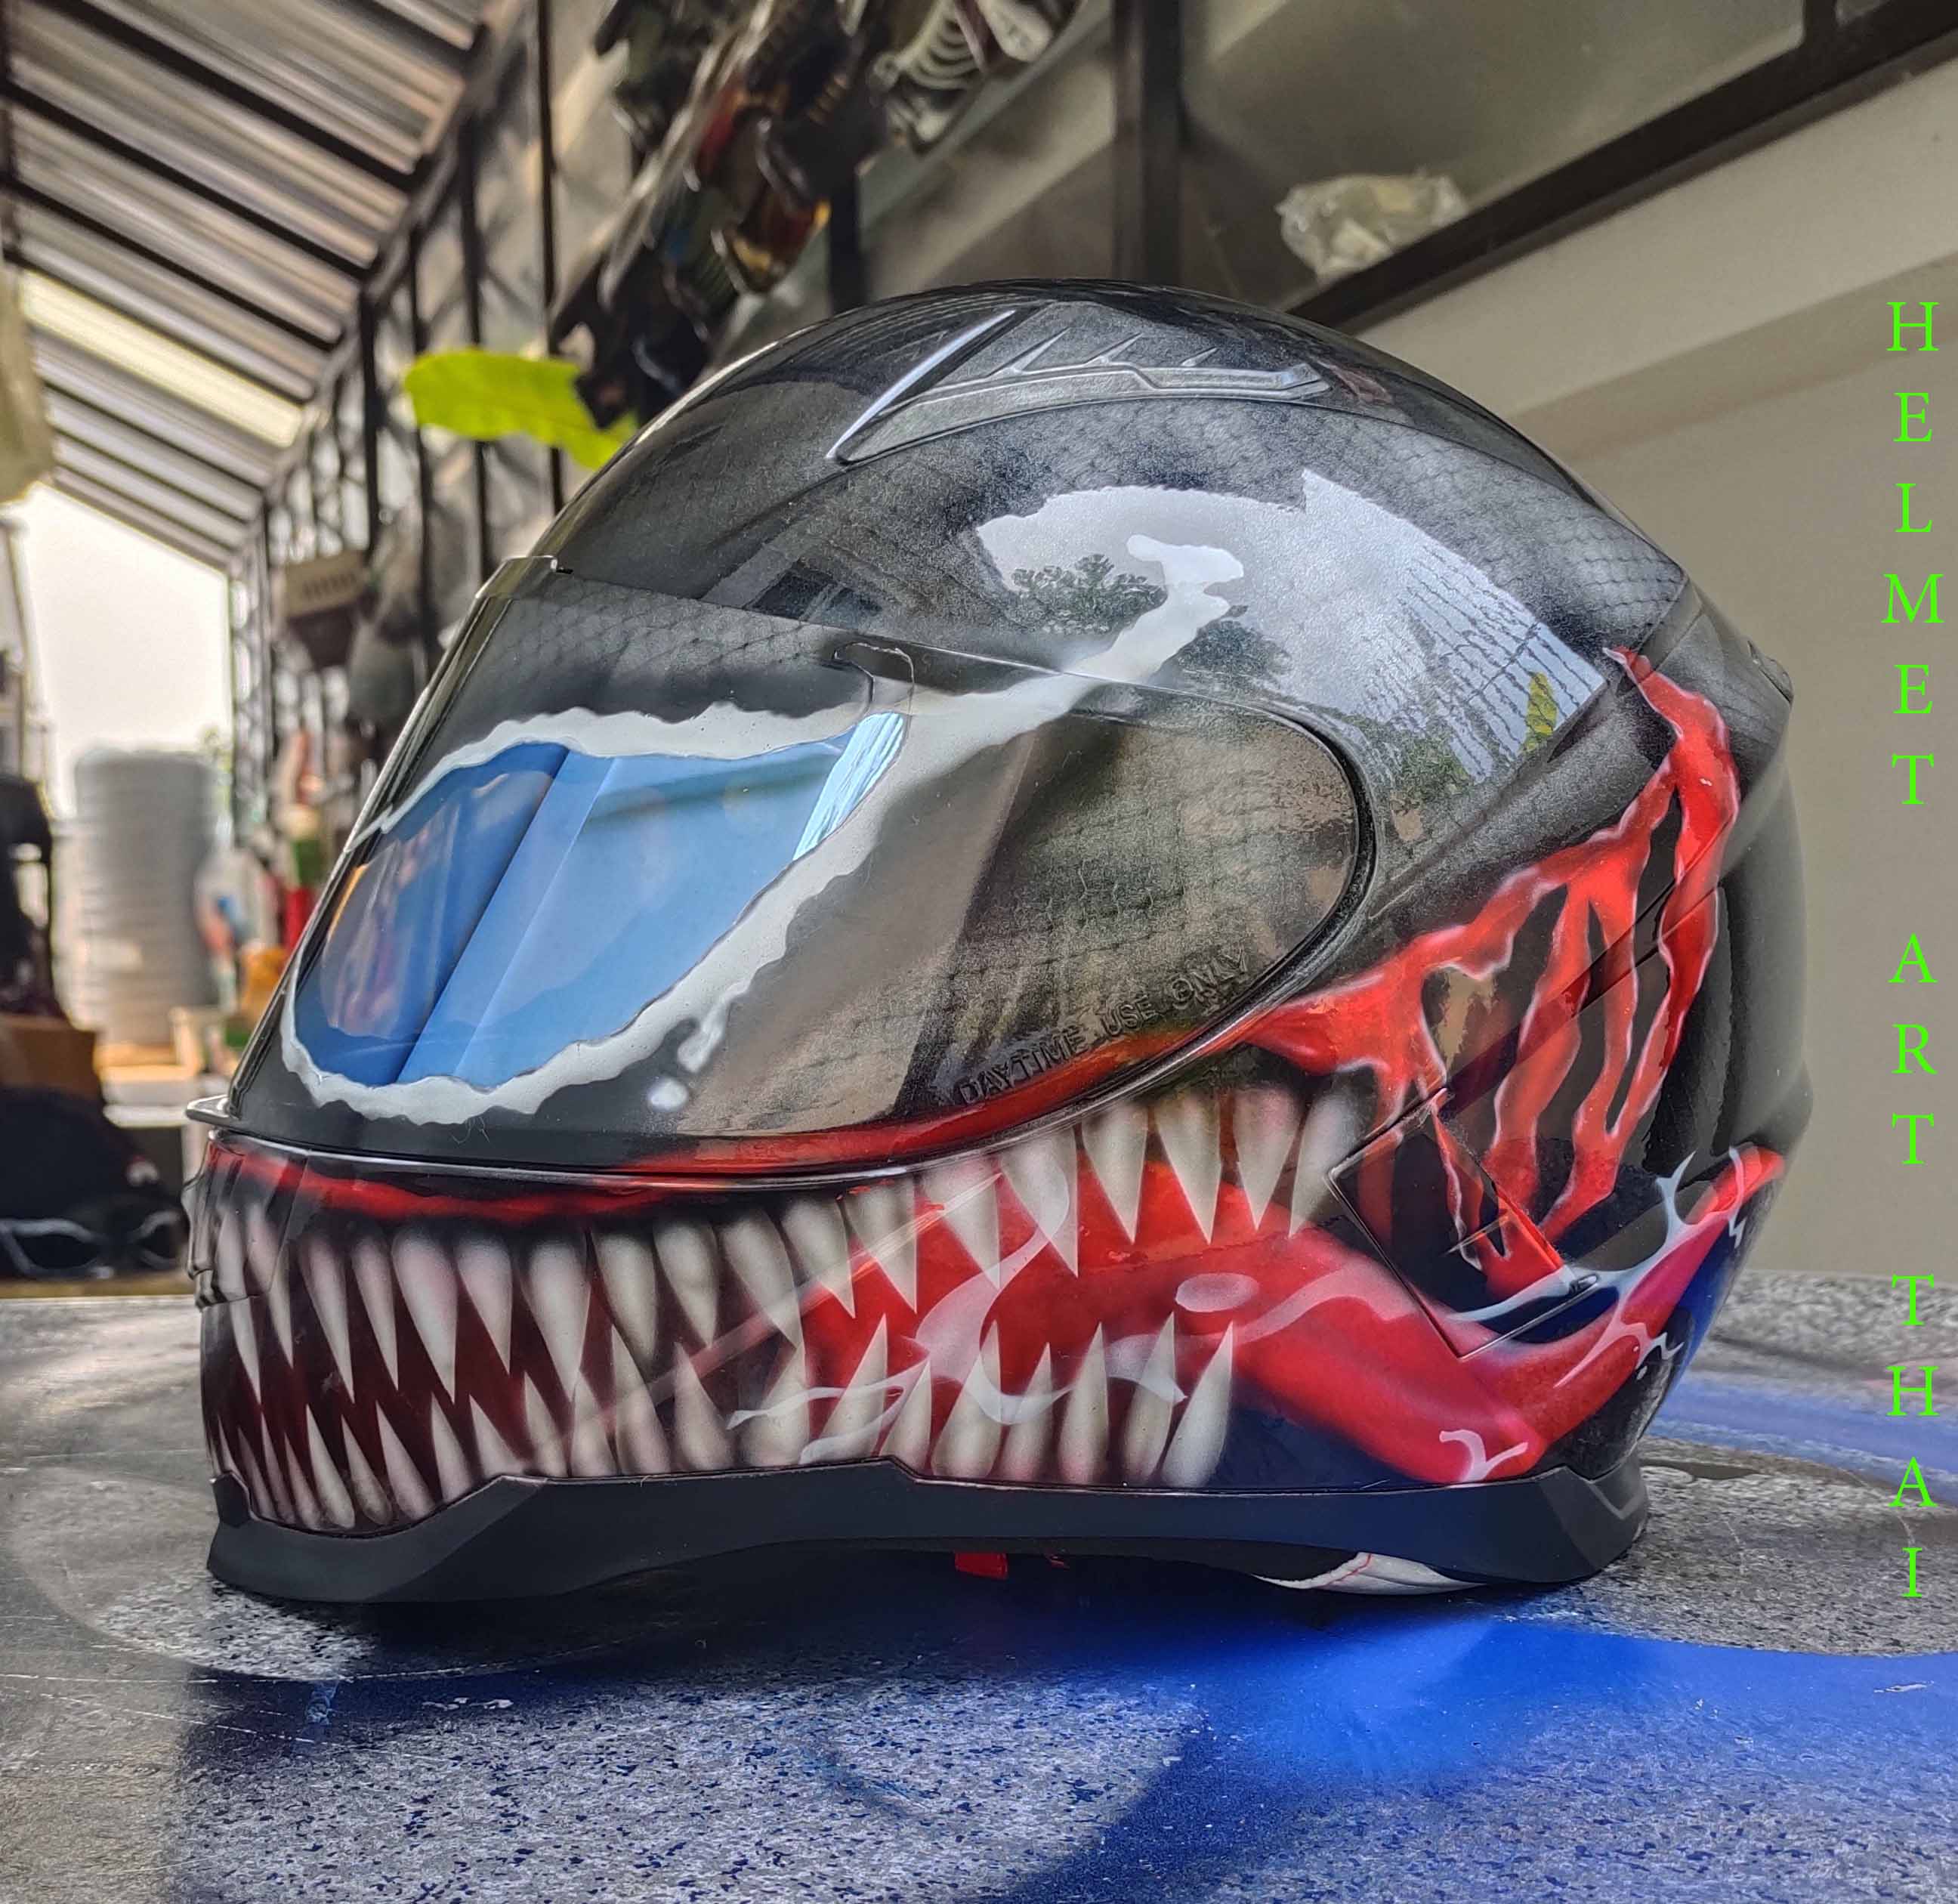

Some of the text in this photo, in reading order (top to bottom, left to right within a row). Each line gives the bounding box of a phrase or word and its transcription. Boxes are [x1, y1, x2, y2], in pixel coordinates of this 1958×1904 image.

[959, 947, 1248, 1105] DAYTIME USE ONLY
